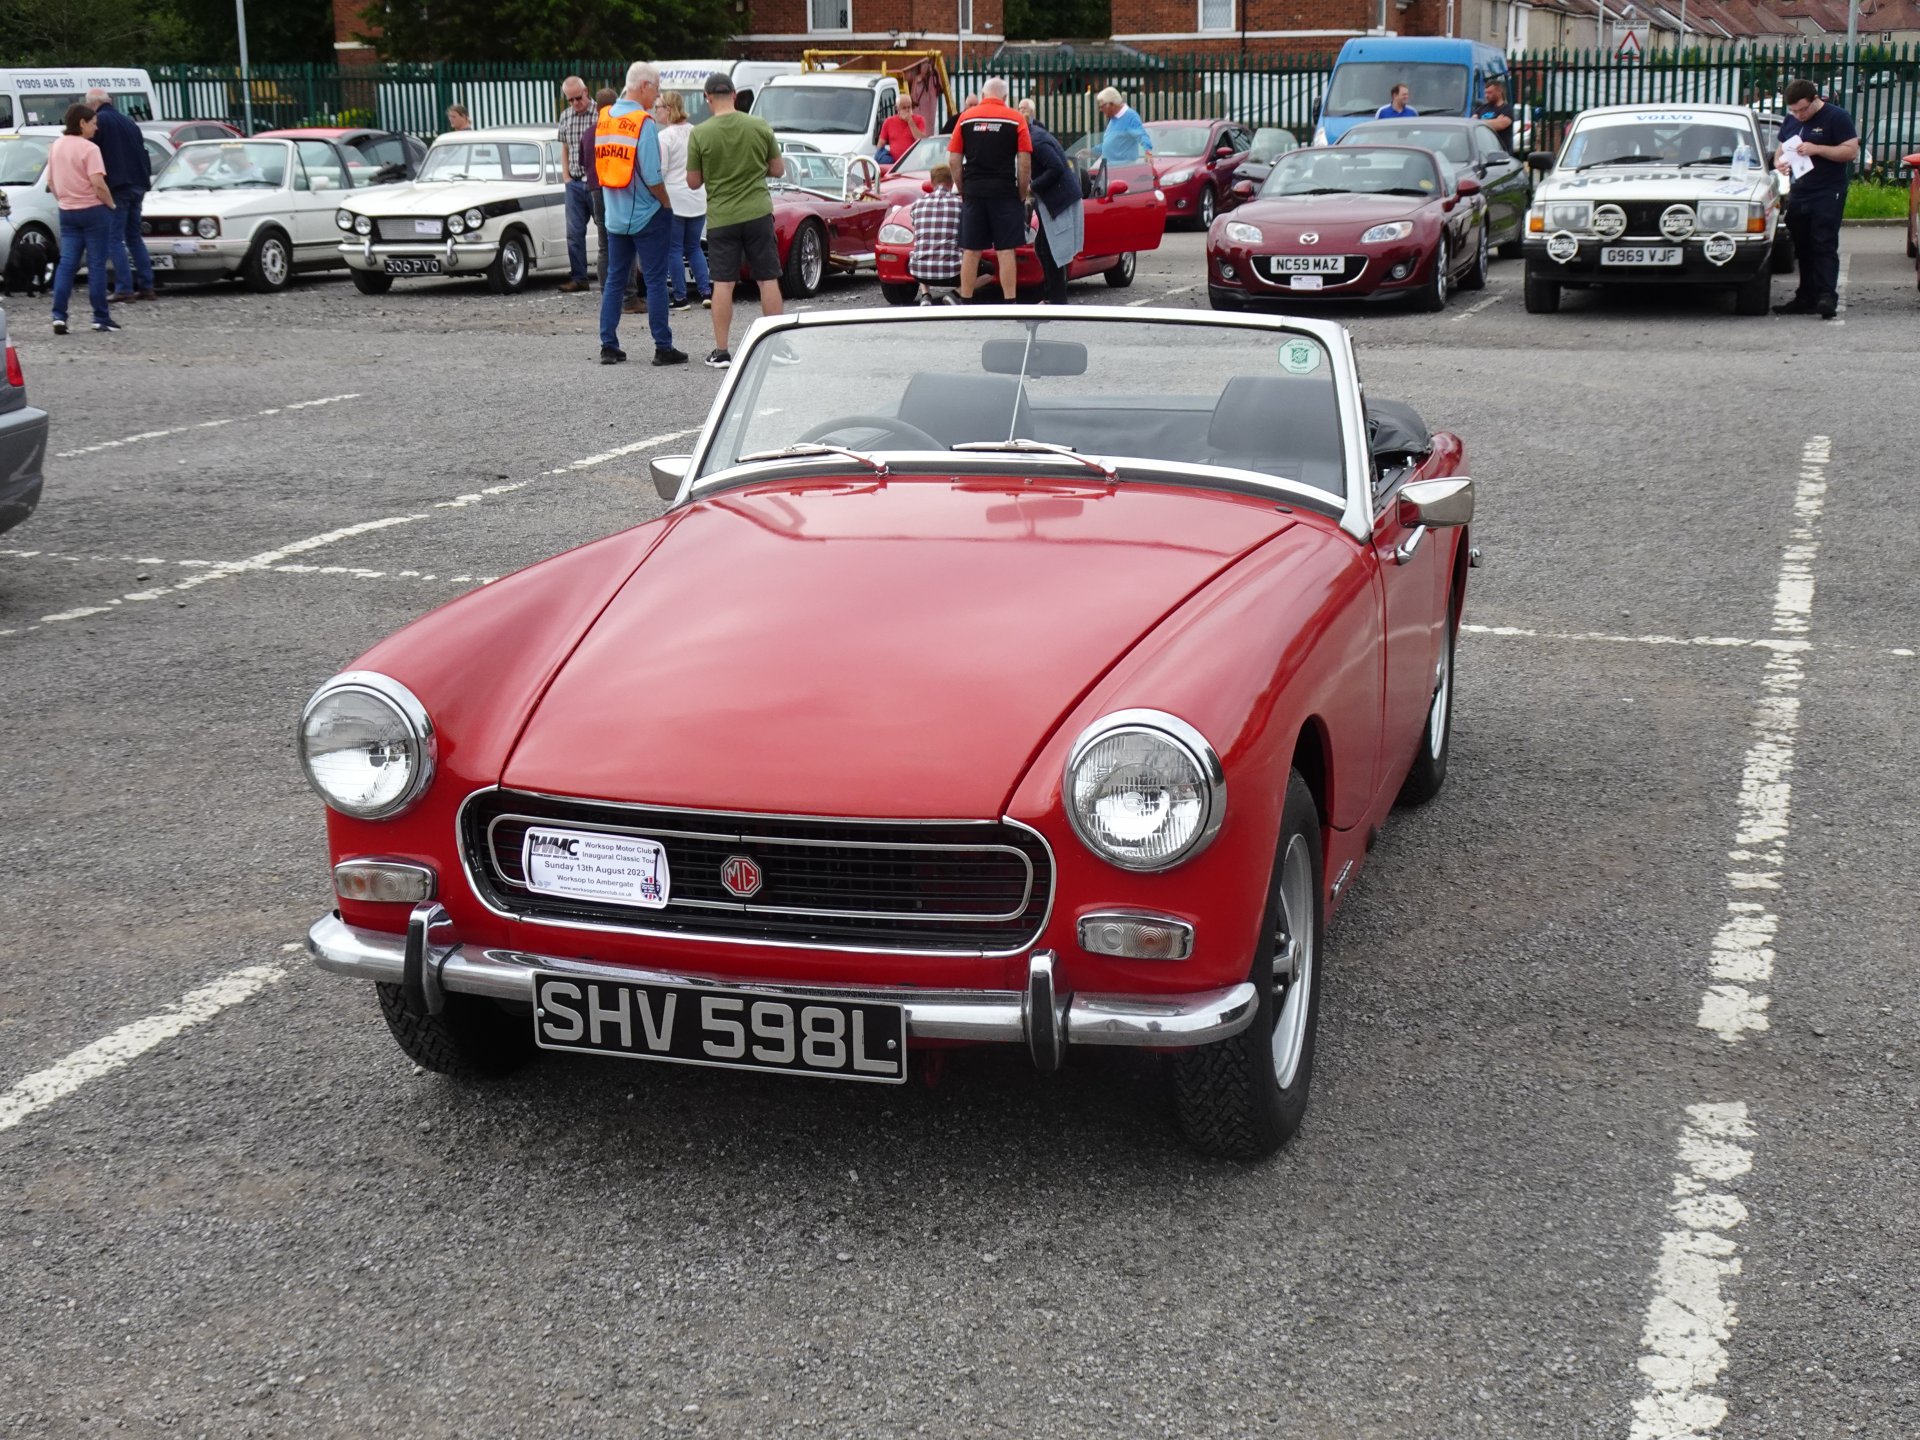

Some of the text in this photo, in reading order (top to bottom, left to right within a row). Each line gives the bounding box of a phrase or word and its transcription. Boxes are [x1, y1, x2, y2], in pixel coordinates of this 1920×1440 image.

[16, 78, 41, 89] 01909
[43, 78, 59, 89] 484
[60, 78, 75, 89] 605
[618, 120, 637, 132] Brit
[595, 145, 631, 160] MASHAL
[1559, 172, 1744, 190] NORDICA
[1665, 219, 1691, 227] Hella
[1708, 243, 1733, 252] Hella
[1607, 249, 1676, 262] G969 VJF
[386, 260, 439, 272] 306 PVO
[1276, 258, 1339, 271] NC59 MAZ
[533, 835, 580, 857] WMC
[584, 841, 652, 854] Worksop Motor Club
[582, 851, 656, 864] Inaugural Classic Tou
[544, 860, 646, 877] Sunday 13th August 2023
[556, 874, 587, 884] Worksop
[596, 877, 634, 889] Ambergate
[726, 860, 757, 891] MG
[539, 980, 898, 1074] SHV 598L
